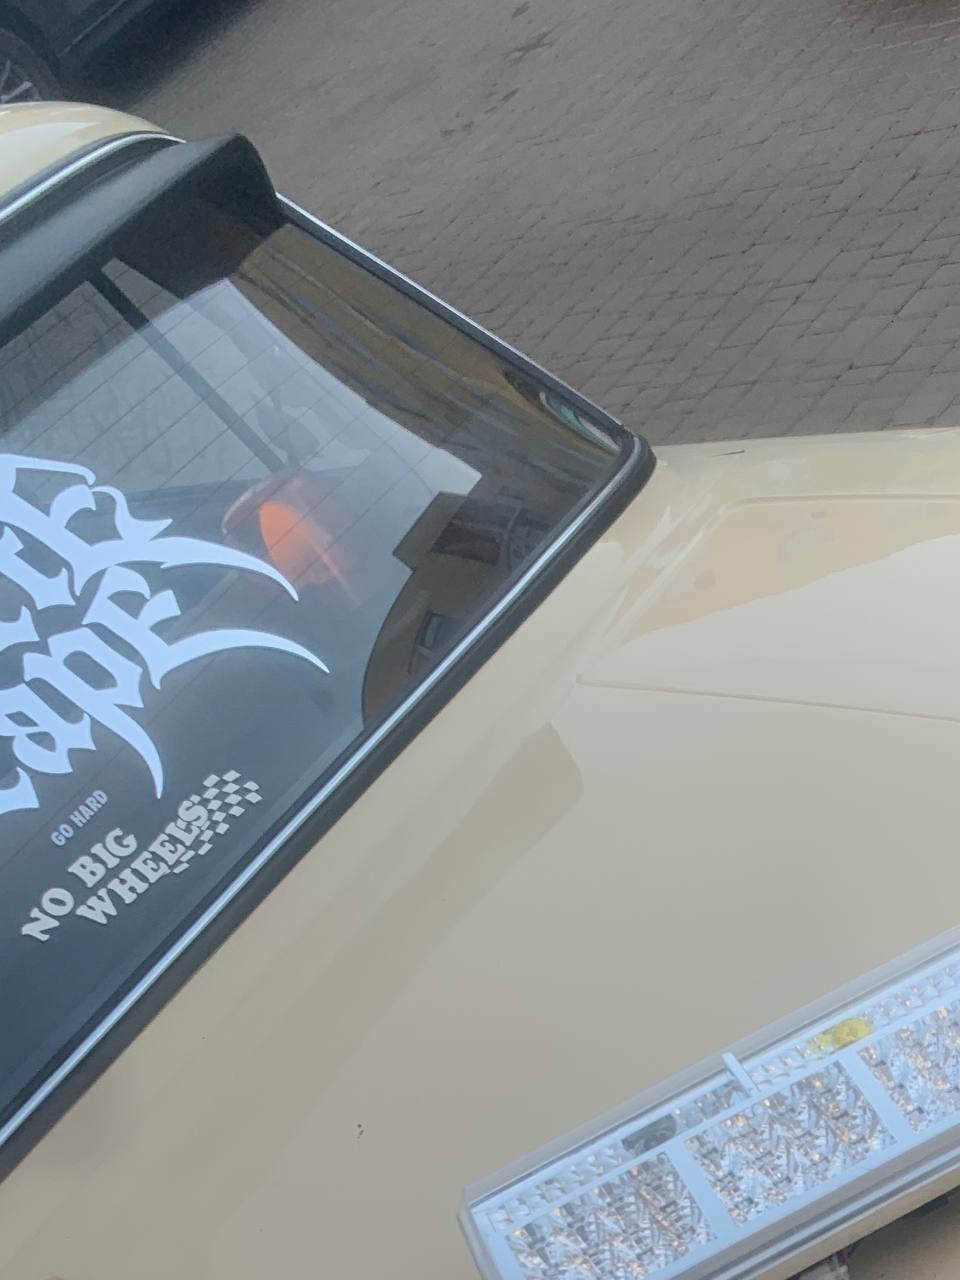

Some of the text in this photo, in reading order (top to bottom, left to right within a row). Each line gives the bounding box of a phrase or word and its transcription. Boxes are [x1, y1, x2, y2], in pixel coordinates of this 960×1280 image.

[50, 789, 108, 847] GO HARD
[75, 798, 209, 925] WHEELS
[21, 827, 138, 942] NO BIG
